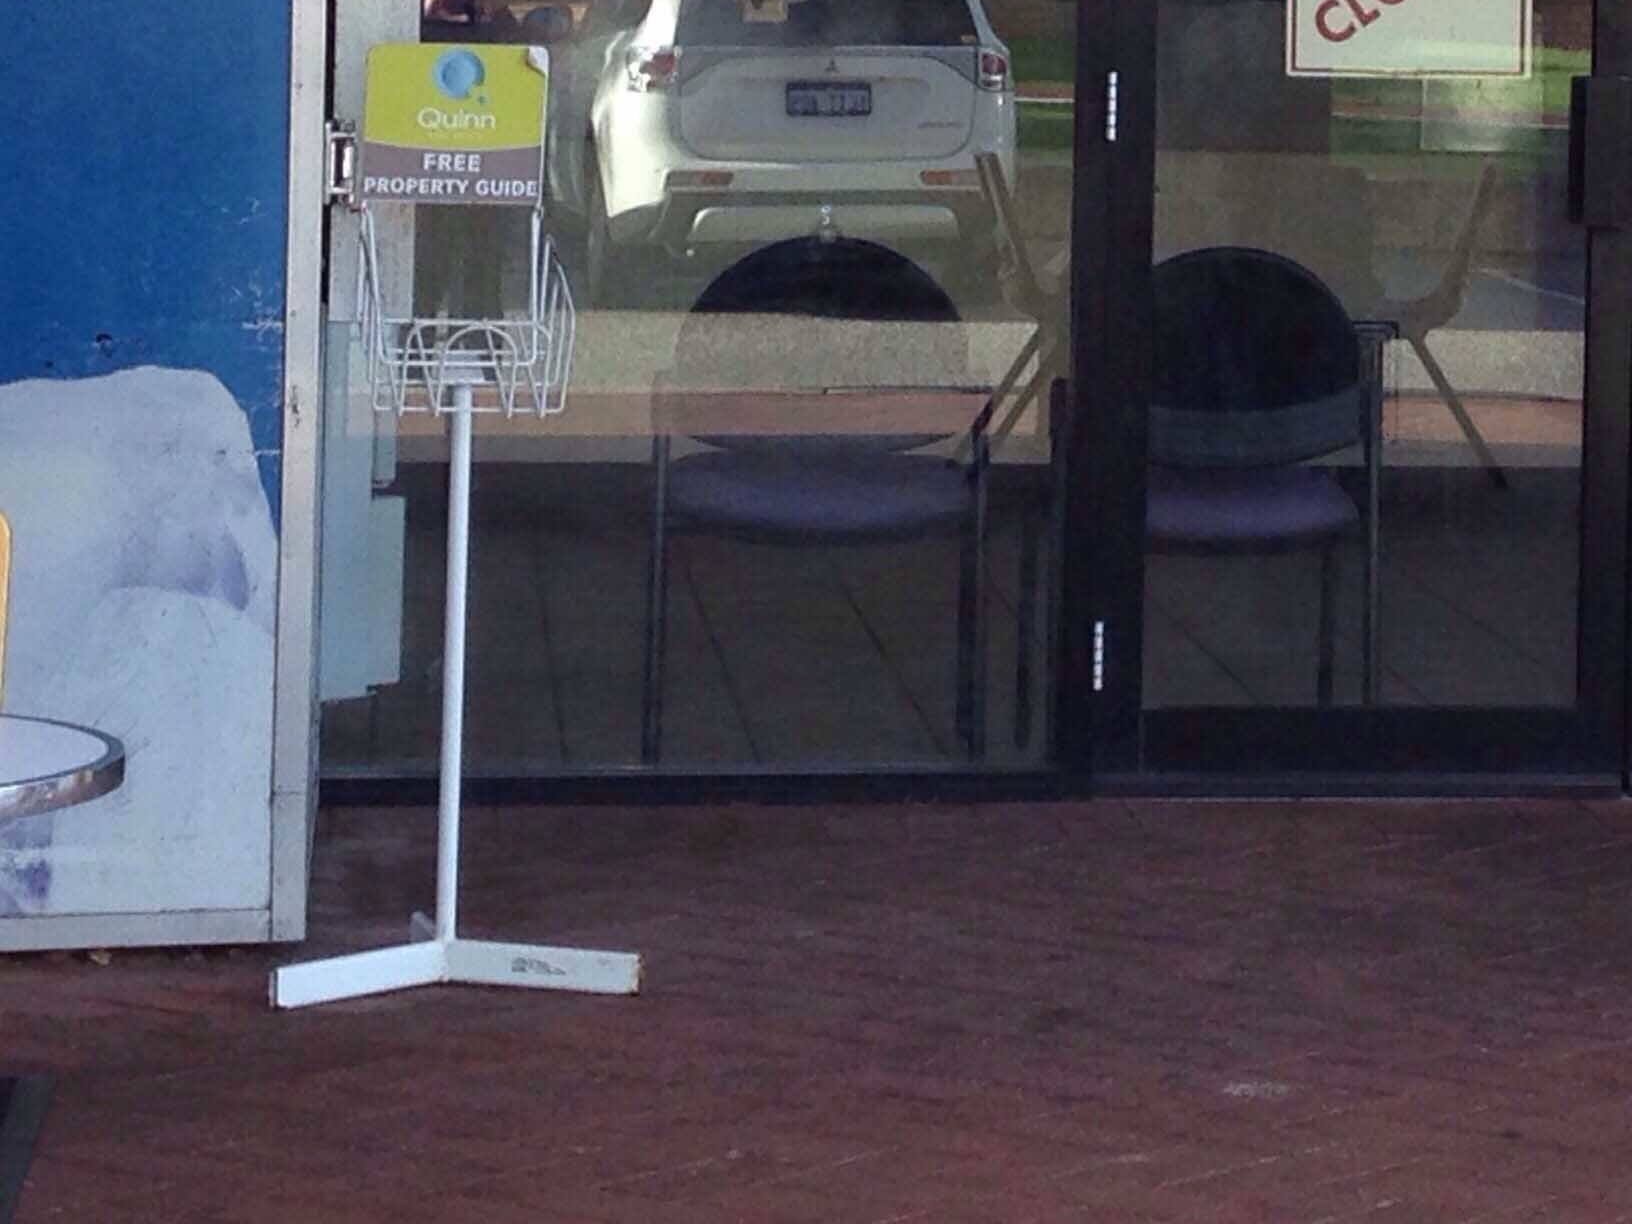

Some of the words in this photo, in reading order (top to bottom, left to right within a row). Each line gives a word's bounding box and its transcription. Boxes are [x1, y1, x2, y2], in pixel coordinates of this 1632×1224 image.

[417, 107, 496, 129] Quinn
[423, 153, 482, 172] FREE
[364, 177, 469, 196] PROPERTY
[476, 179, 538, 197] GUIDE
